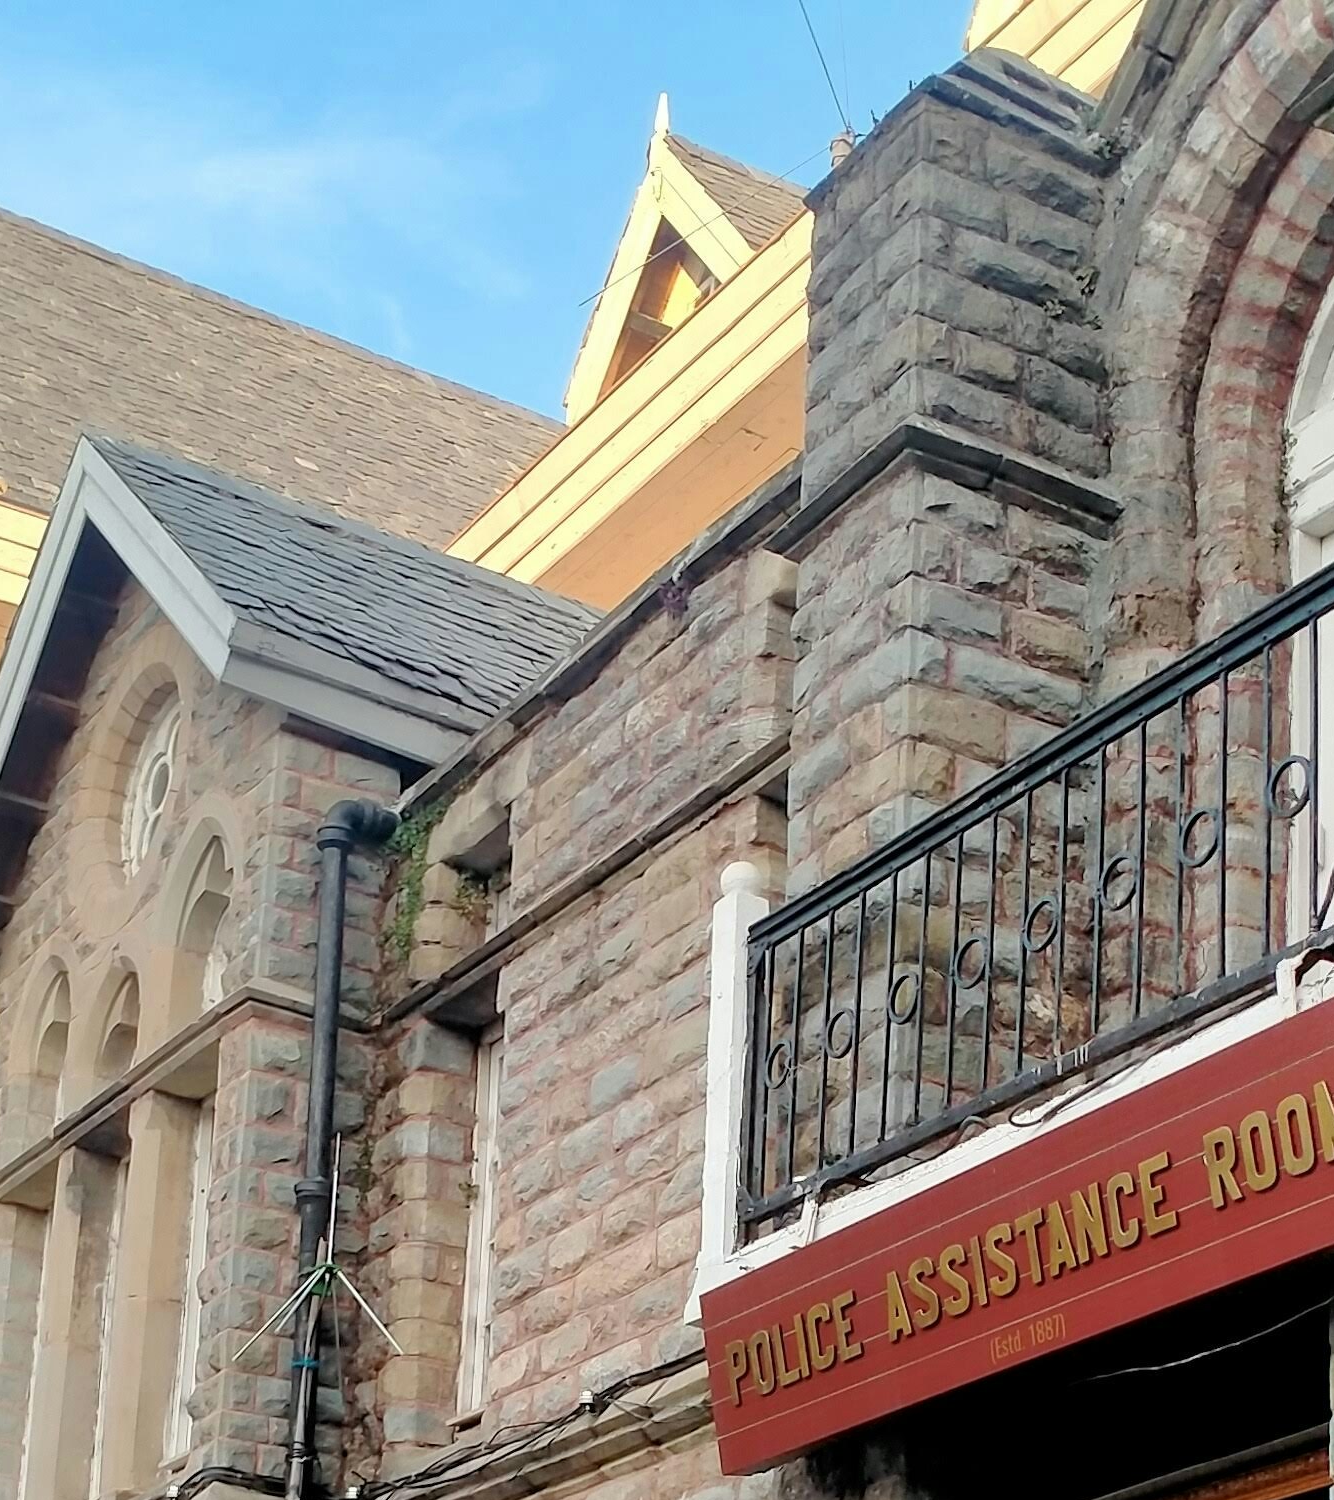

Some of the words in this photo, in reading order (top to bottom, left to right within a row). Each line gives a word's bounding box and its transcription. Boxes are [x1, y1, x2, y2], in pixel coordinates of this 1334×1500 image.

[725, 1289, 863, 1406] POLICE
[887, 1151, 1178, 1343] ASSISTANCE
[990, 1330, 1025, 1364] (Estd.
[1028, 1313, 1066, 1345] 1887)
